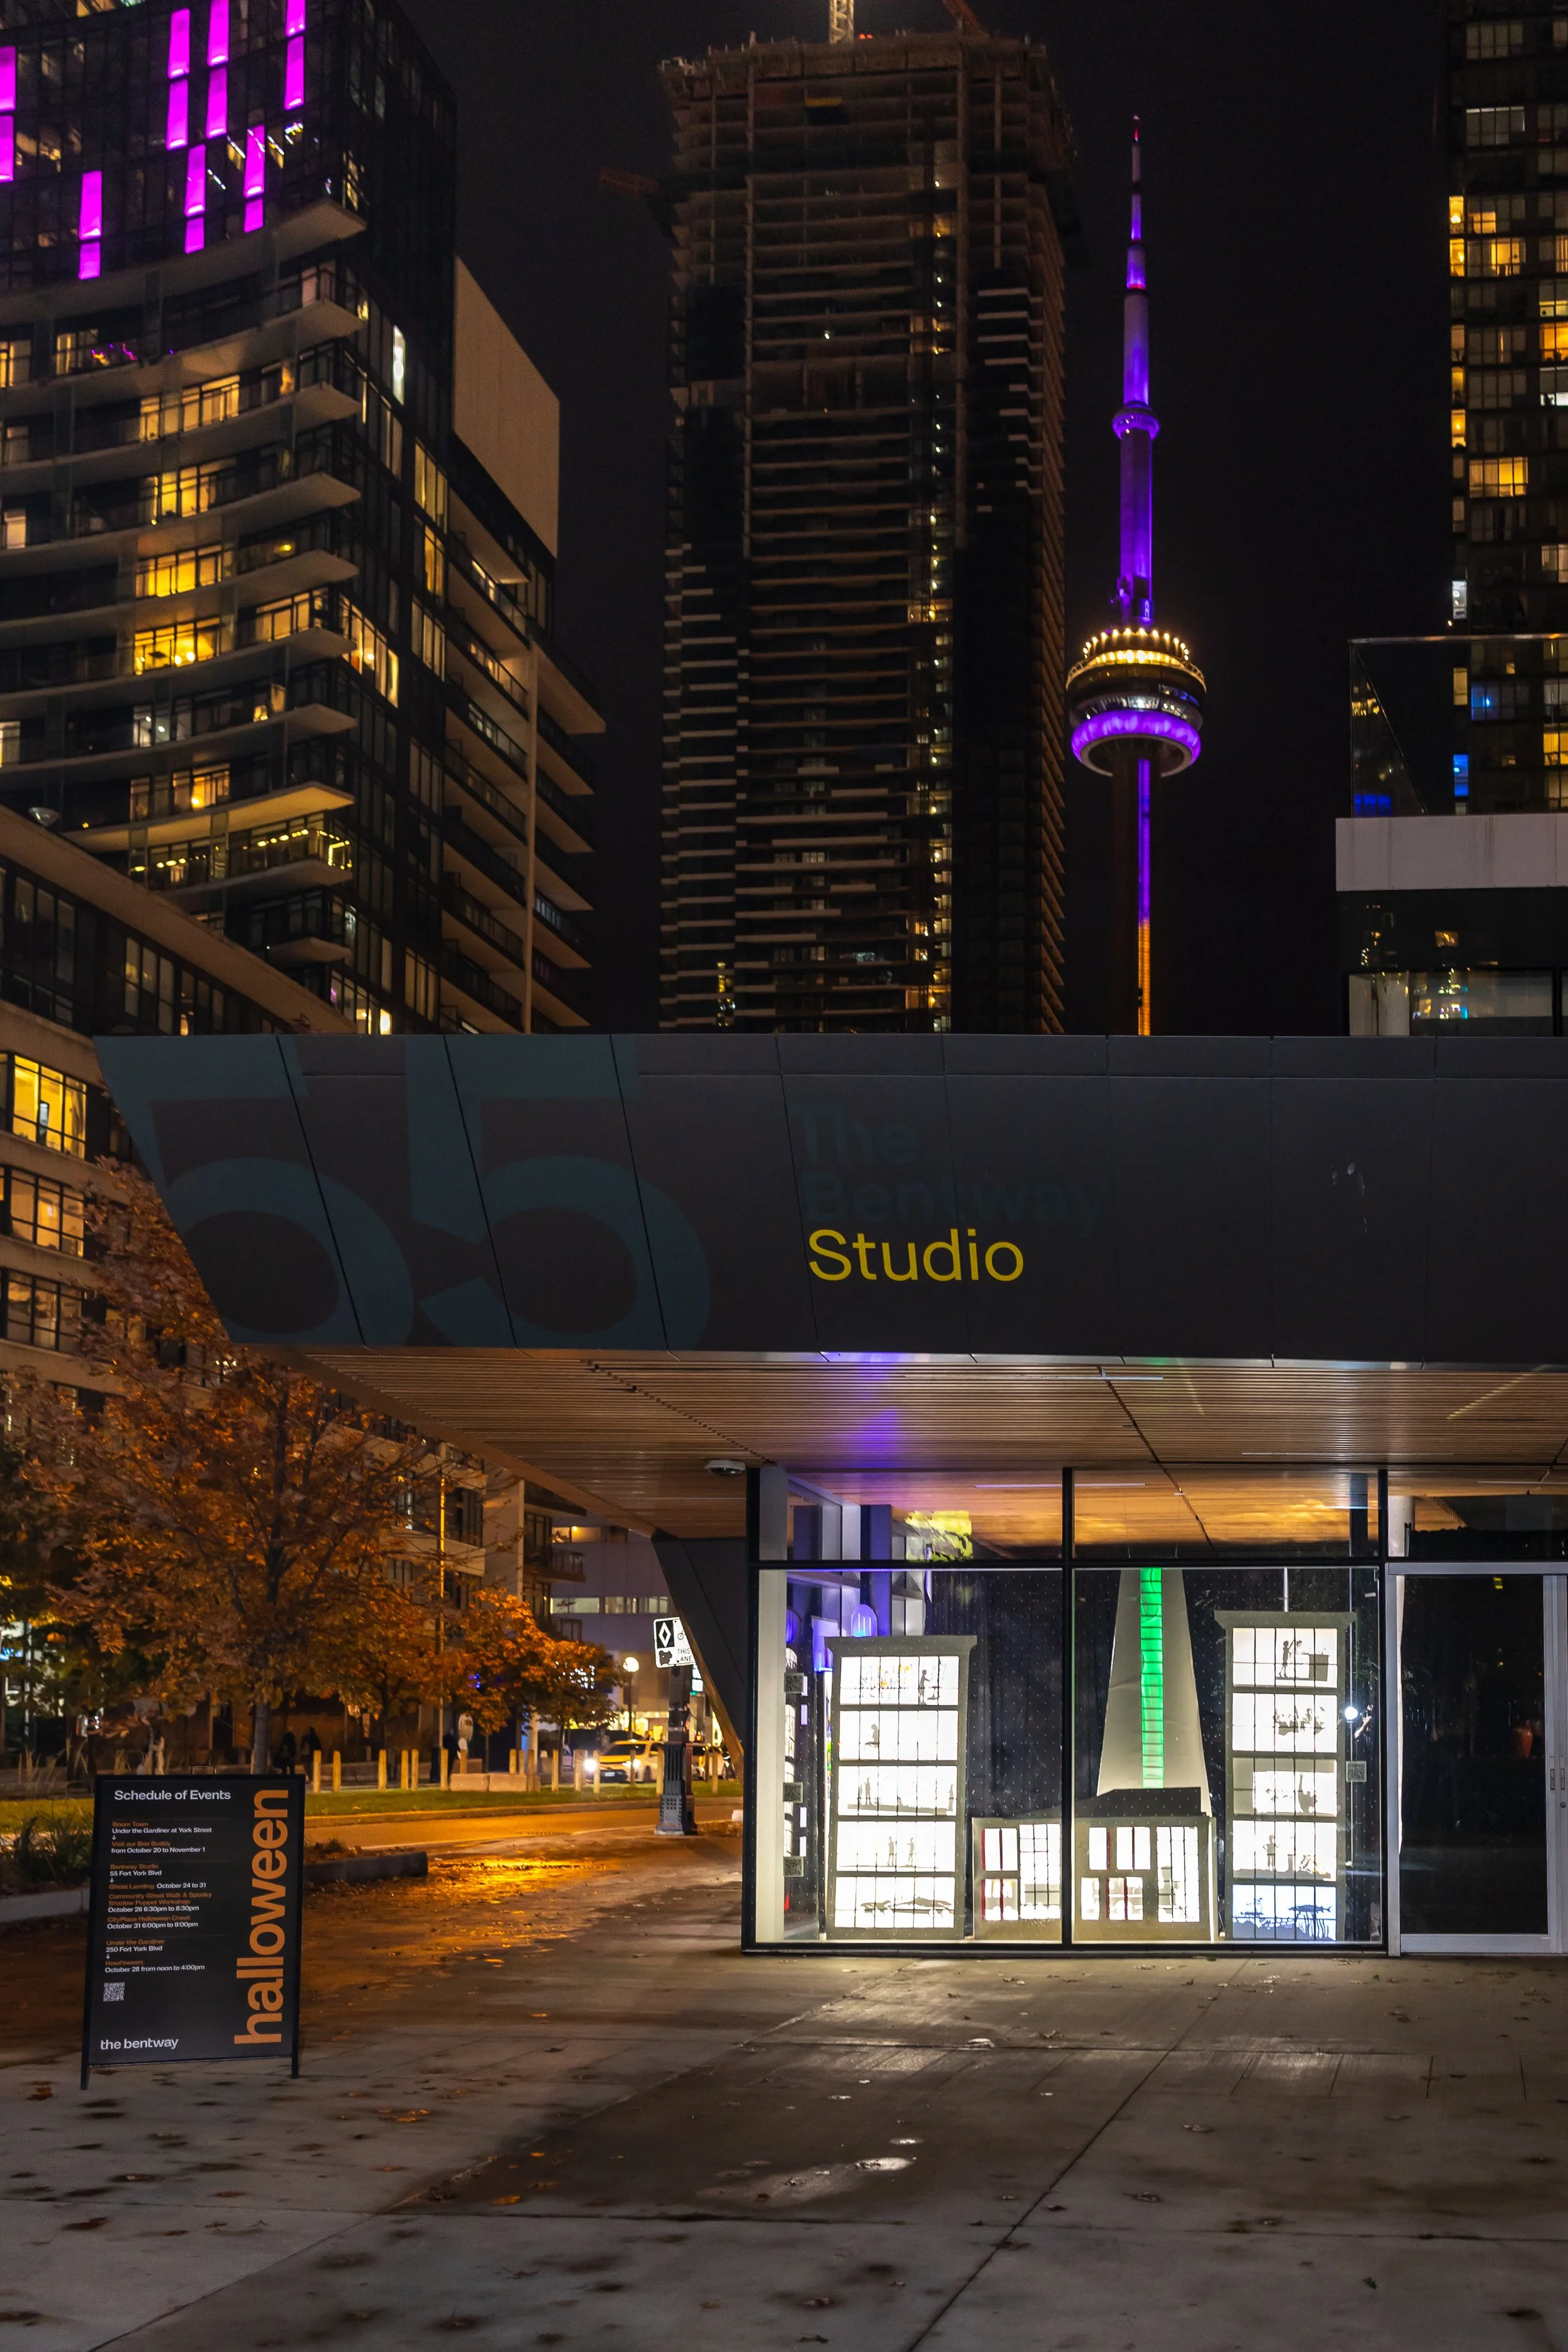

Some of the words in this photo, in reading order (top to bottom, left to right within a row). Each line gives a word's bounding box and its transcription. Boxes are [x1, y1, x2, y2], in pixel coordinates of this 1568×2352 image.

[93, 1034, 711, 1349] 55
[808, 1228, 1024, 1281] Studio
[114, 1790, 172, 1800] Schedule
[174, 1790, 188, 1800] of
[190, 1790, 231, 1800] Events
[234, 1789, 289, 2045] halloween
[100, 2040, 121, 2050] the
[124, 2038, 178, 2049] bentway
